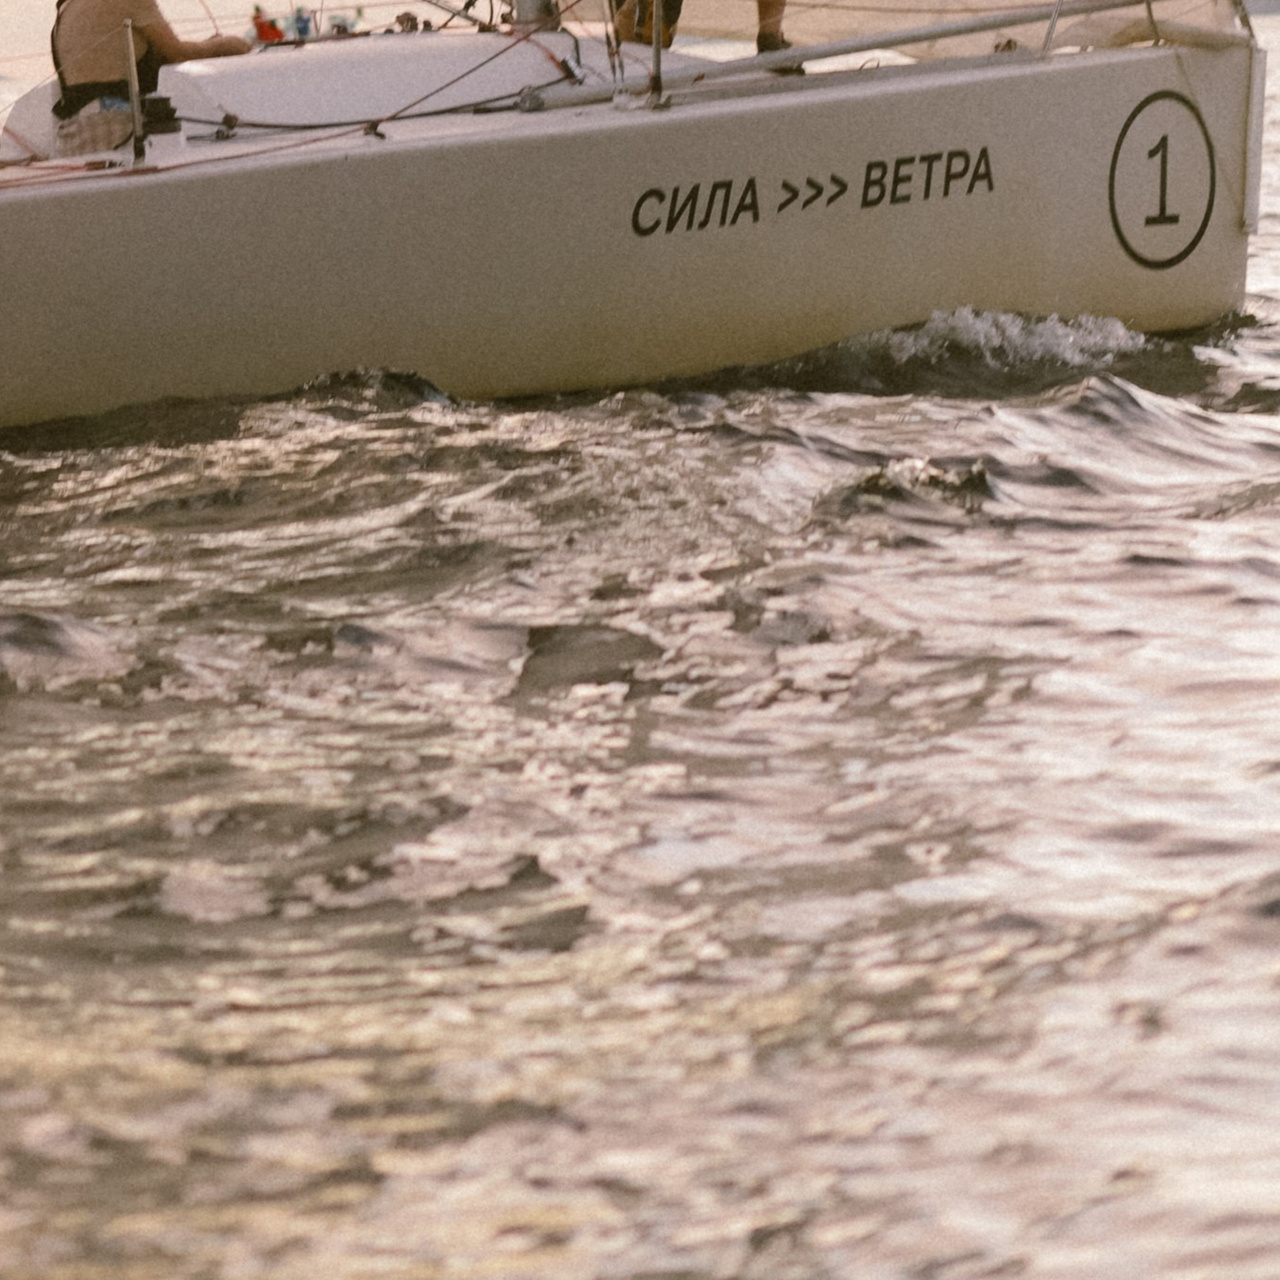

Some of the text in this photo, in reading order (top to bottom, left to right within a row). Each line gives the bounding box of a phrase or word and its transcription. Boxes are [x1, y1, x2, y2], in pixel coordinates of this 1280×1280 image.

[631, 146, 995, 238] СИЛА ВЕТРА
[1144, 135, 1180, 227] 1
